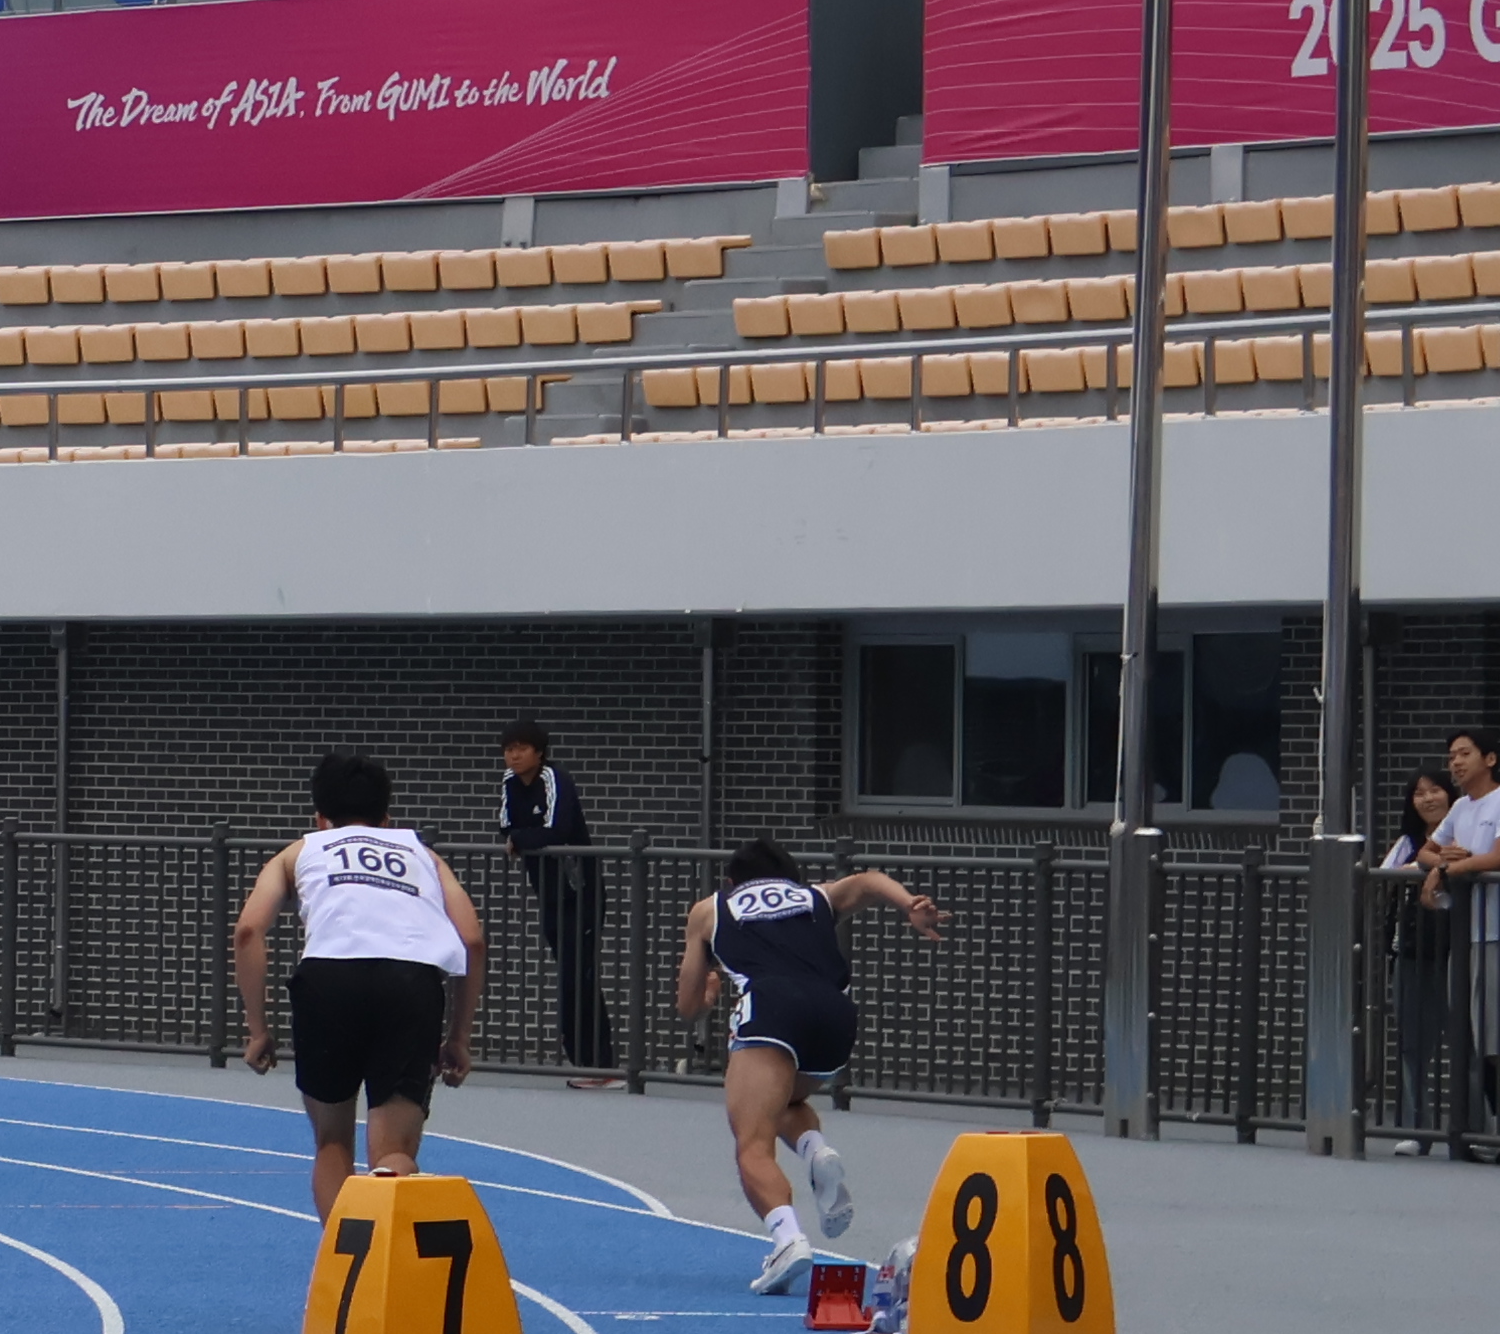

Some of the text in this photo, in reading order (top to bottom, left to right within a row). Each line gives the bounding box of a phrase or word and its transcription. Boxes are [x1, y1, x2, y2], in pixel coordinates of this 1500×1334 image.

[67, 89, 117, 130] The
[119, 88, 198, 127] Dream
[201, 80, 238, 129] of
[315, 77, 371, 117] From
[376, 72, 450, 121] GUMI
[454, 79, 479, 109] to
[482, 72, 521, 107] the
[526, 56, 618, 107] World
[333, 846, 407, 878] 166
[946, 1172, 998, 1323] 8
[1045, 1173, 1085, 1323] 8
